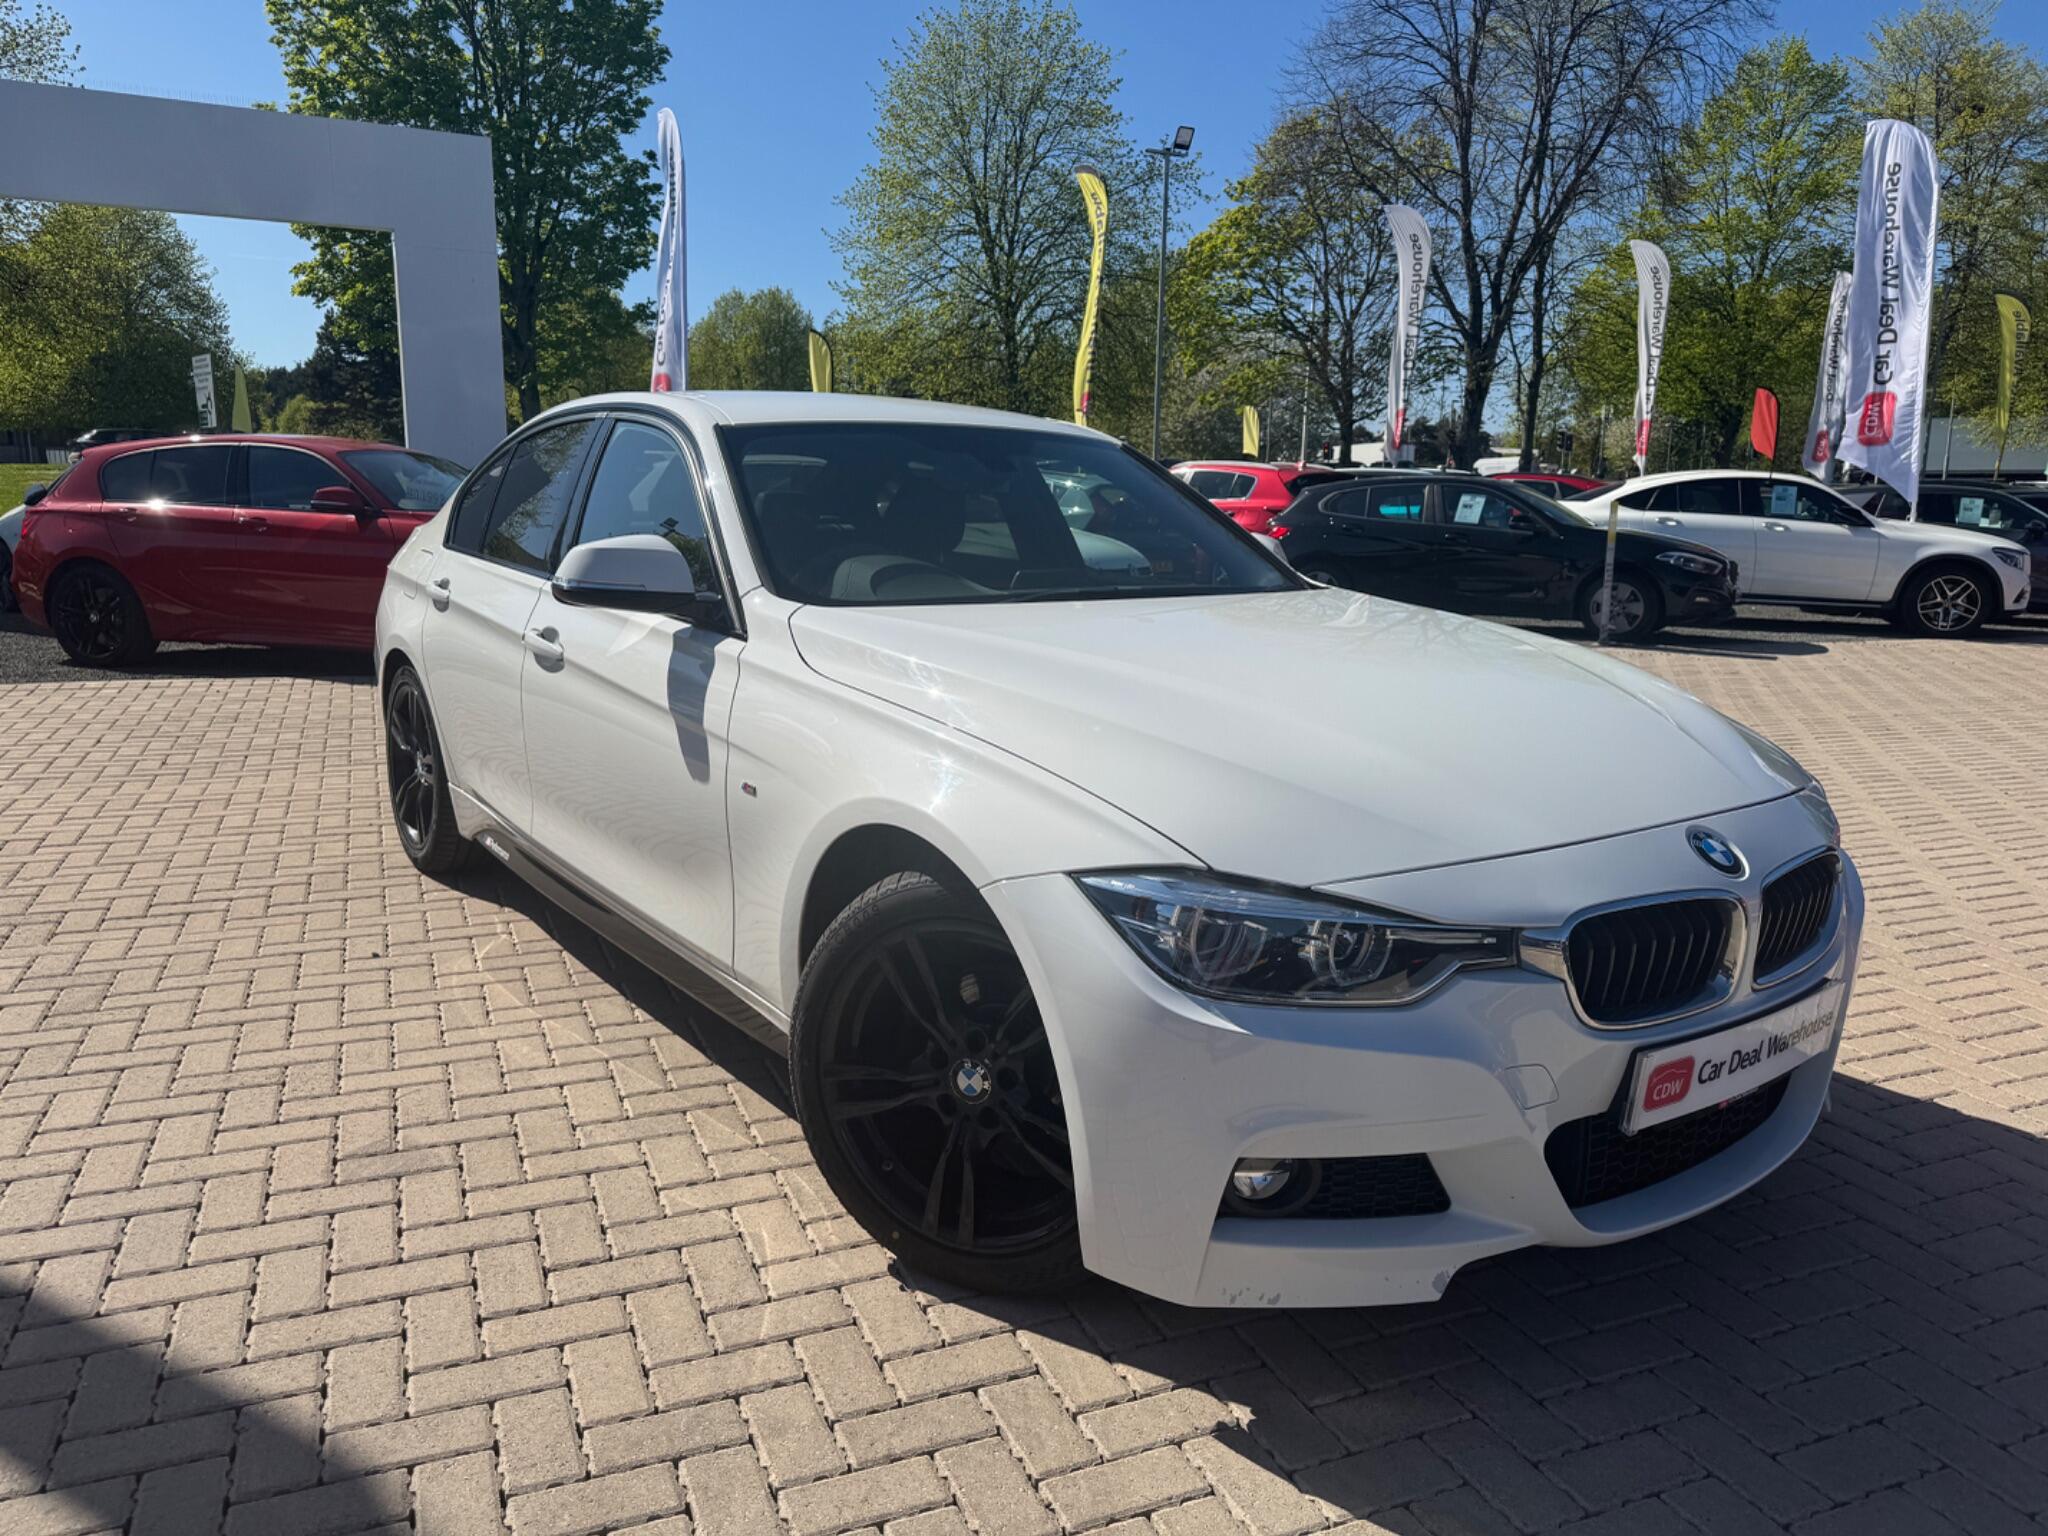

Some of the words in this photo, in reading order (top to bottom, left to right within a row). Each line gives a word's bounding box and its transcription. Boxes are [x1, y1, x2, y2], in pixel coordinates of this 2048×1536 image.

[1698, 1058, 1727, 1085] Car
[1728, 1041, 1763, 1076] Deal
[1767, 1010, 1834, 1058] Warehouse
[1653, 1079, 1685, 1101] CDW
